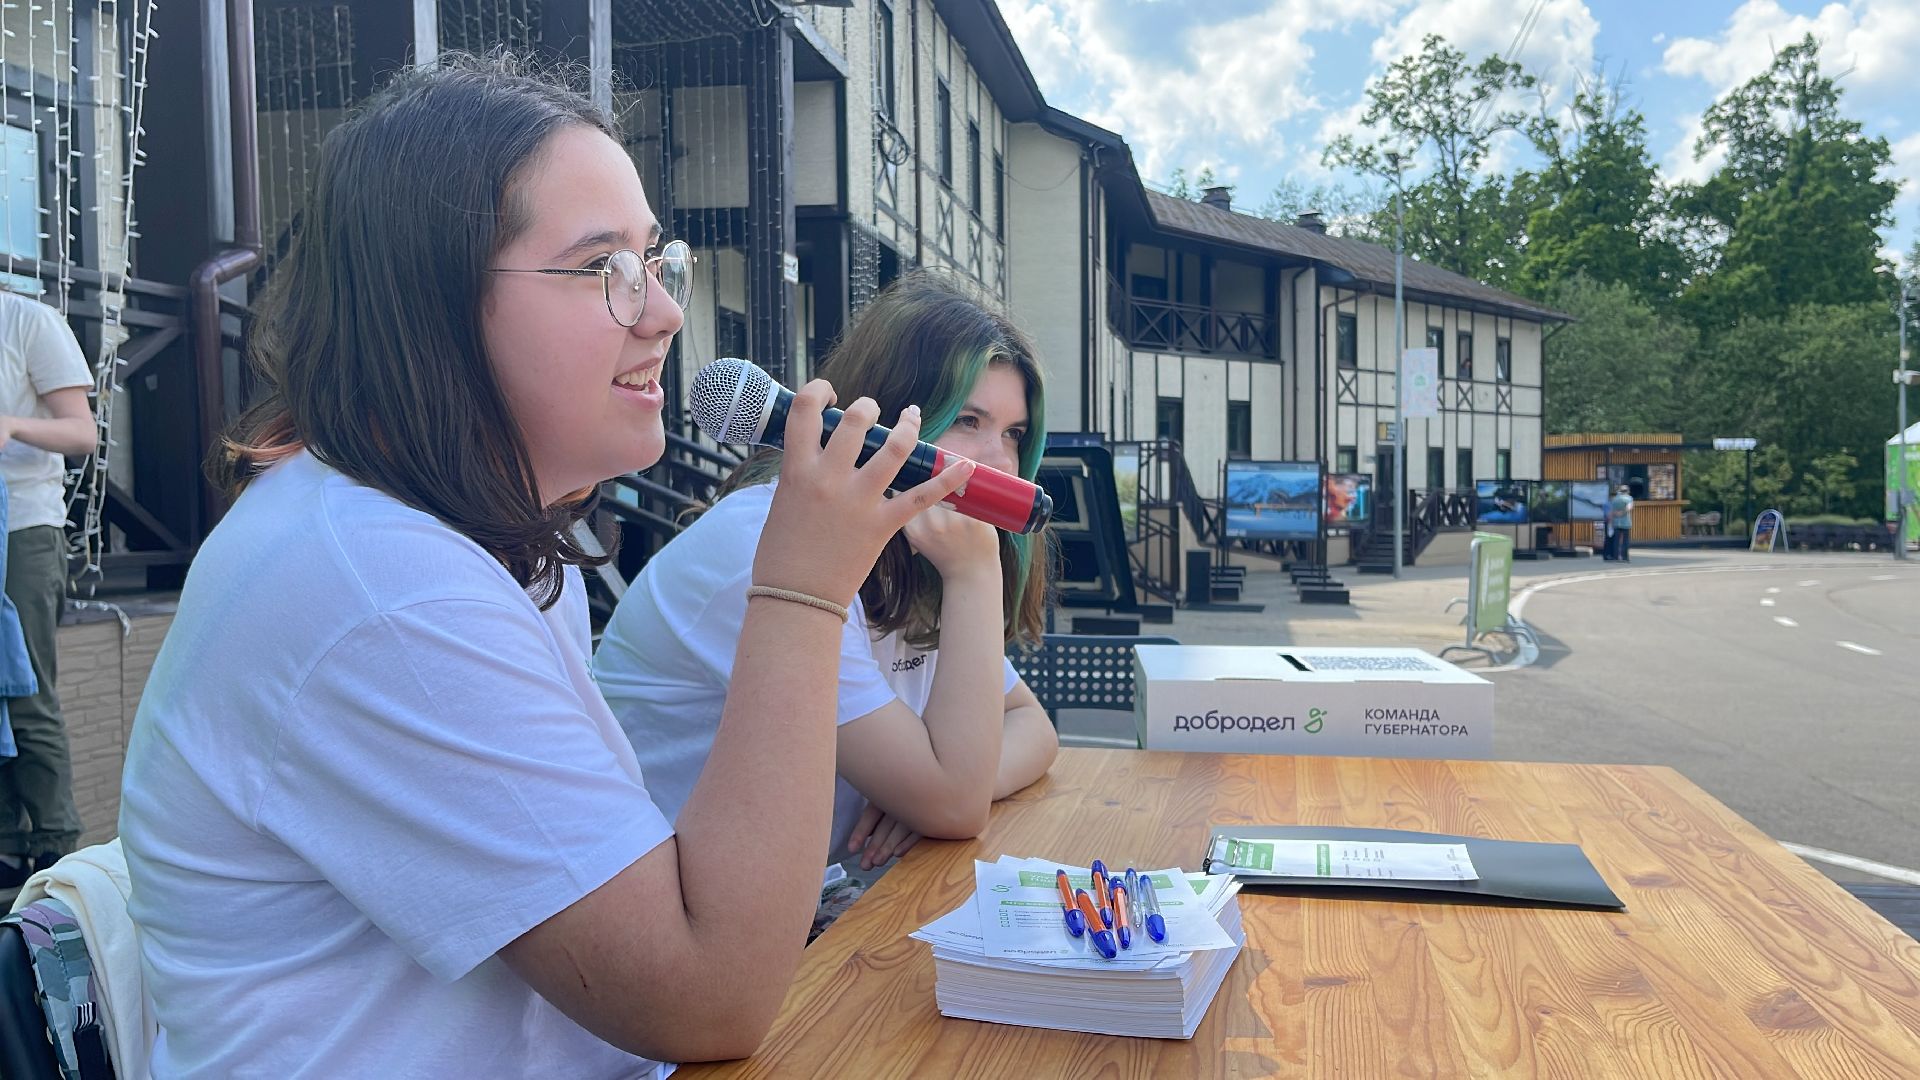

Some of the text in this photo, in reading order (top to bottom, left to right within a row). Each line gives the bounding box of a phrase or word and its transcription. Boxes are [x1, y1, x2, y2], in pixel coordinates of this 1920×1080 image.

[1365, 708, 1440, 721] КОМАНДА
[1173, 710, 1295, 733] добродел
[1365, 724, 1469, 736] ГУБЕРНАТОРА
